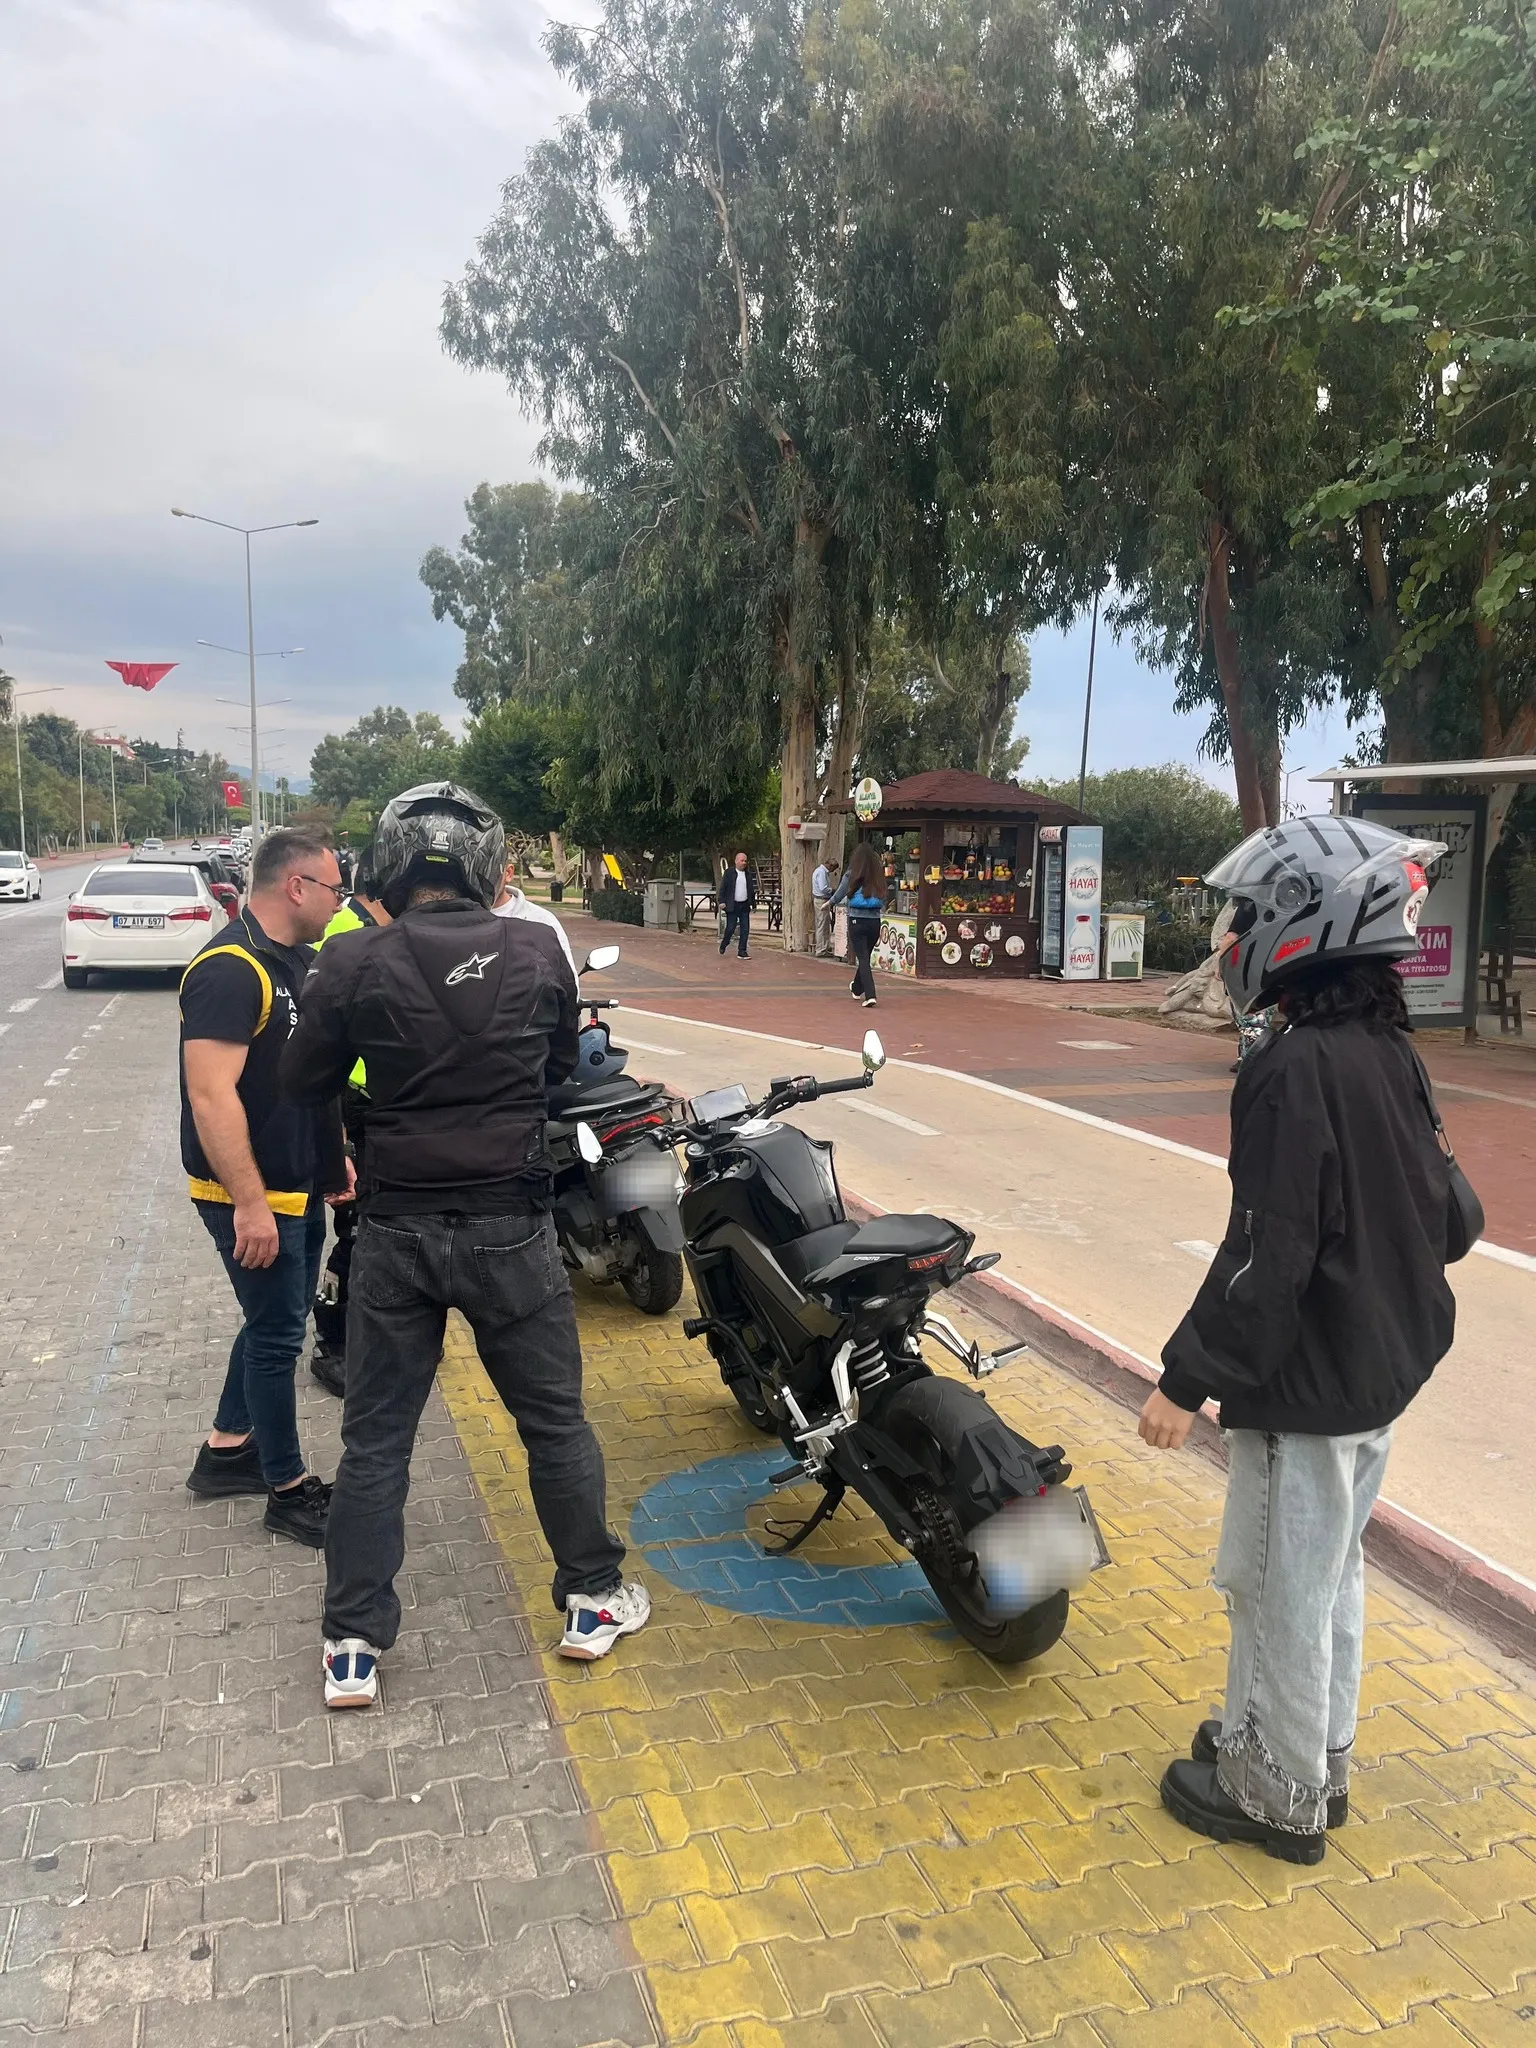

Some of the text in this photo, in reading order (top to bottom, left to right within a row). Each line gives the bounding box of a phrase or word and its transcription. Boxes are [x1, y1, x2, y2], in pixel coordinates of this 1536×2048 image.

[1041, 828, 1059, 840] HAYAT
[1069, 878, 1098, 889] HAYAT
[118, 917, 127, 925] 07
[148, 917, 161, 925] 697
[1415, 927, 1447, 950] KİM
[1070, 953, 1095, 963] HAYAT
